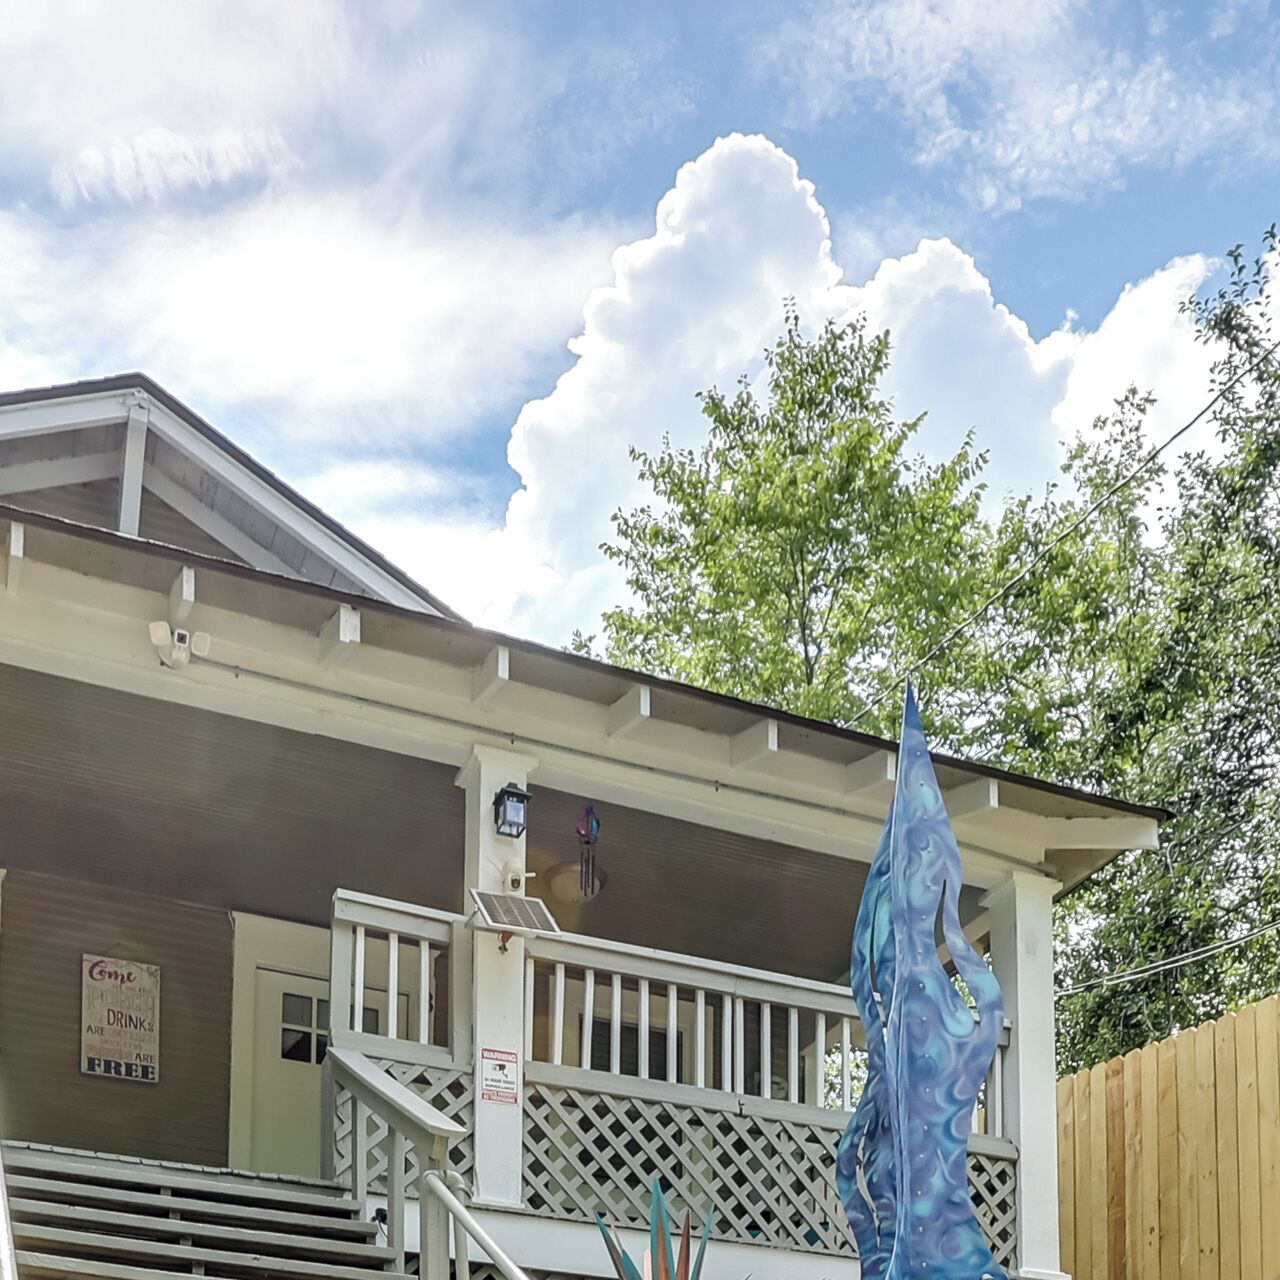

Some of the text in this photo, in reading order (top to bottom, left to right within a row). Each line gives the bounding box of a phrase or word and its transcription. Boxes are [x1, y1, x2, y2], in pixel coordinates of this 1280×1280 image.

[88, 960, 136, 985] Come
[106, 1008, 154, 1032] DRINKS
[86, 1025, 105, 1036] ARE
[134, 1052, 155, 1064] ARE
[483, 1050, 517, 1062] WARNING
[86, 1056, 155, 1080] FREE
